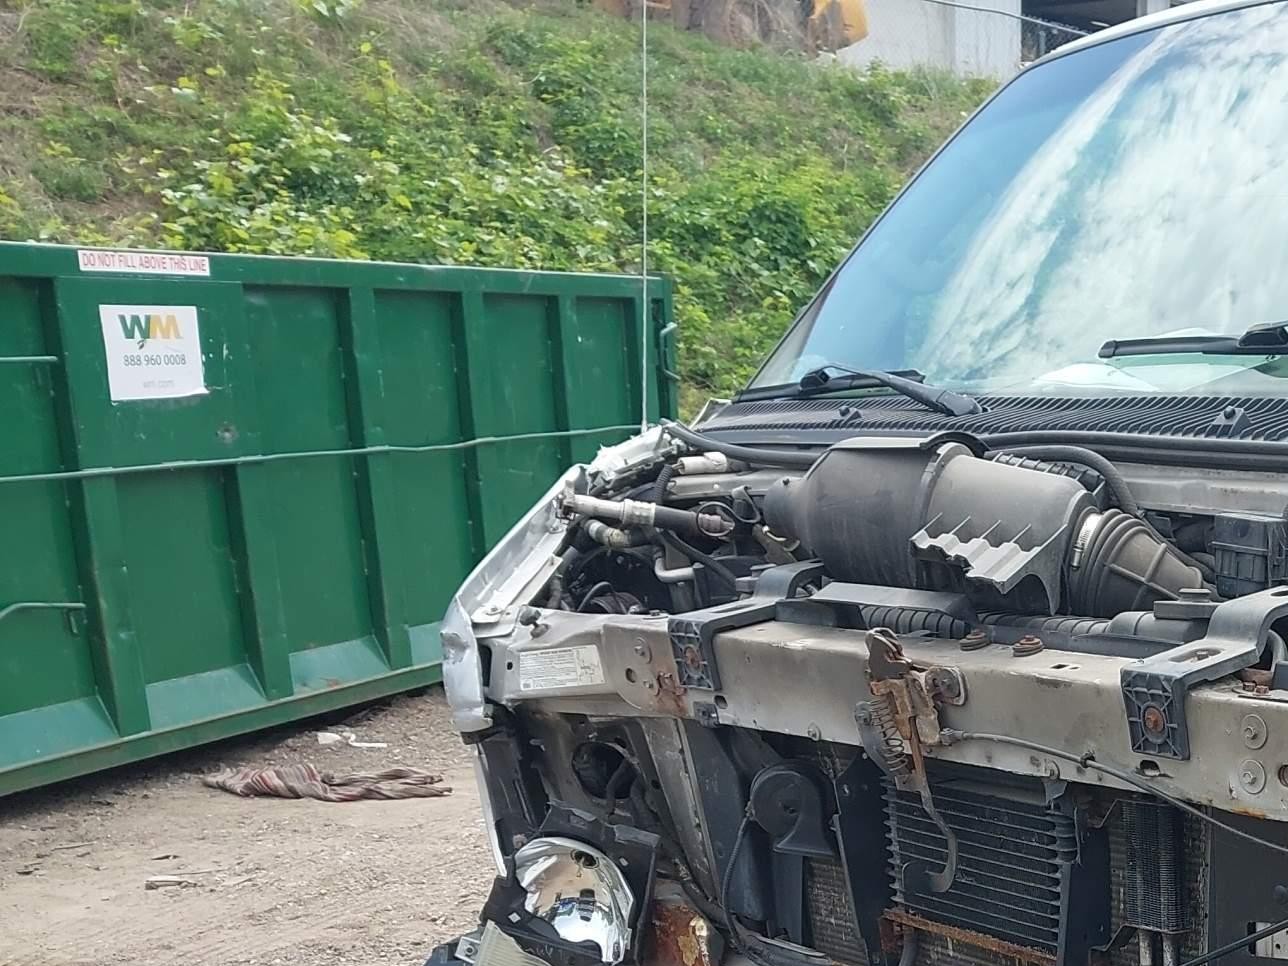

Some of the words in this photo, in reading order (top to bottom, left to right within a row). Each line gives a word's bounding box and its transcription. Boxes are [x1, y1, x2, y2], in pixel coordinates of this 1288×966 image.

[82, 253, 96, 266] DO
[98, 253, 116, 267] NOT
[118, 254, 137, 268] FILL
[139, 255, 168, 270] ABOVE
[169, 256, 187, 271] THIS
[189, 258, 207, 272] LINE
[118, 314, 184, 340] WM
[123, 354, 142, 367] 888
[144, 354, 162, 366] 960
[165, 353, 187, 366] 0008
